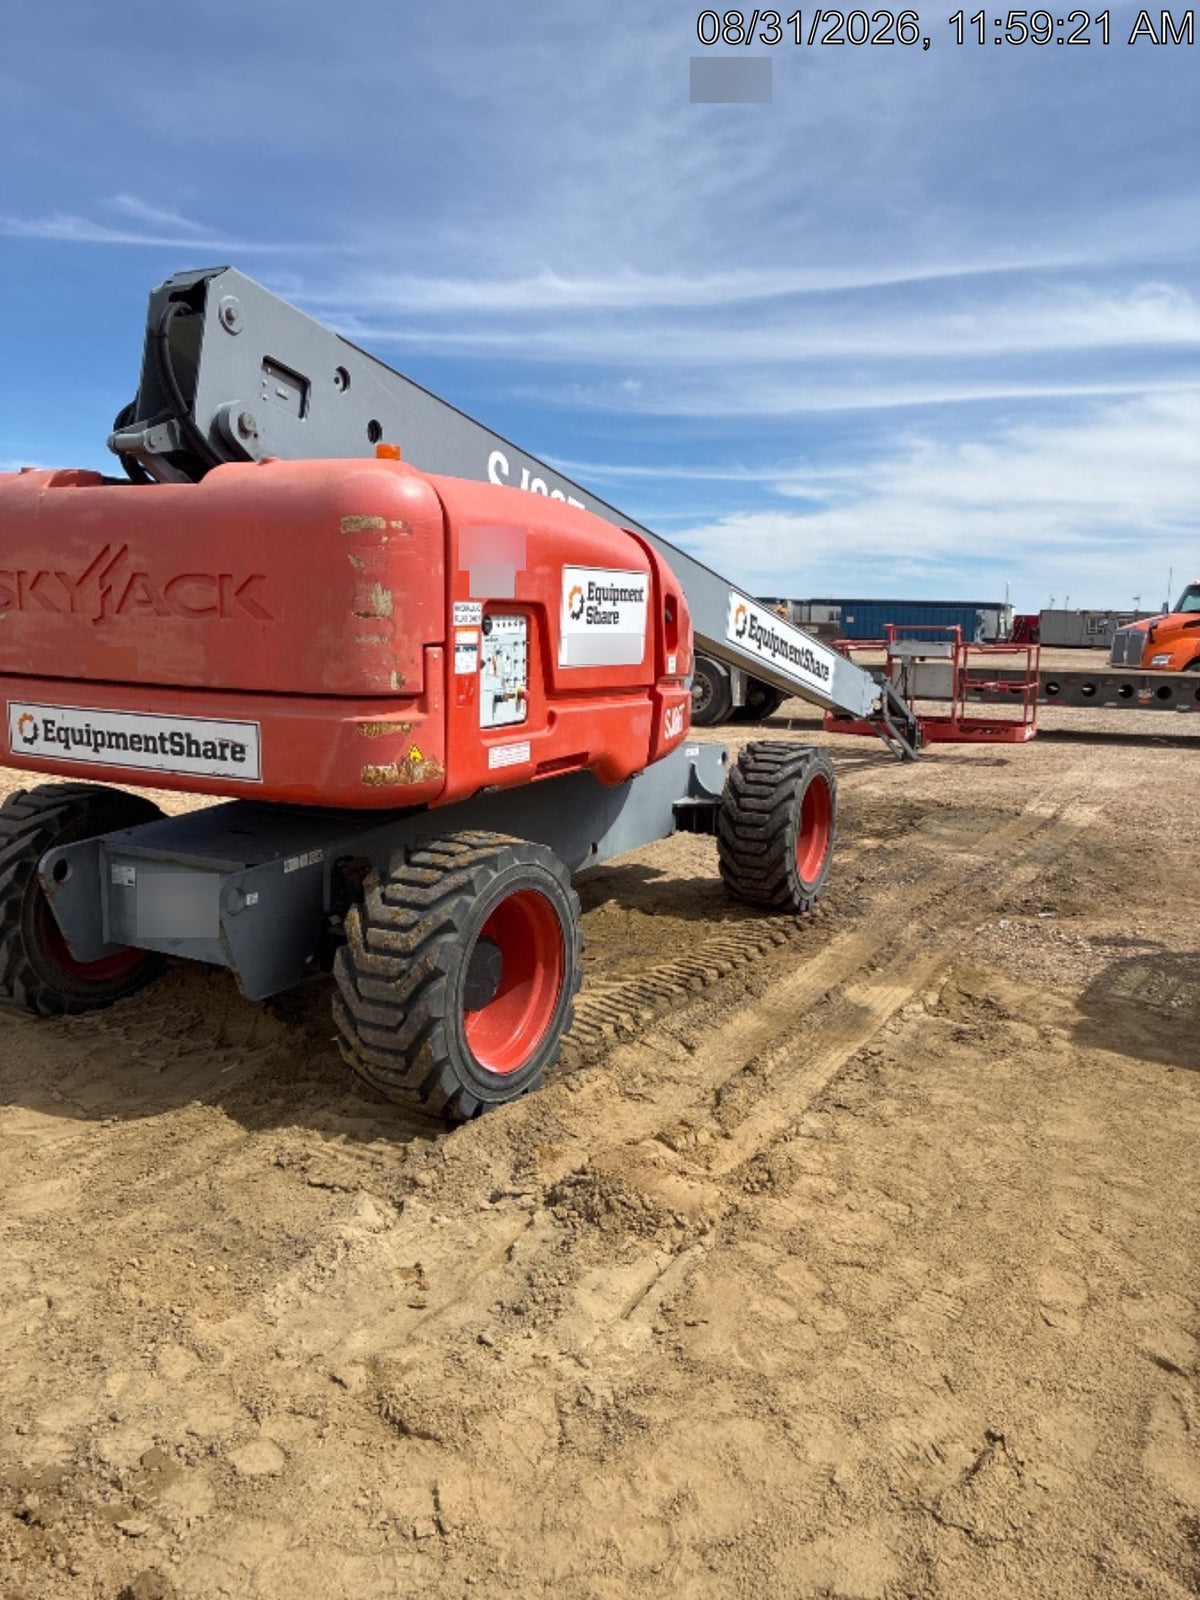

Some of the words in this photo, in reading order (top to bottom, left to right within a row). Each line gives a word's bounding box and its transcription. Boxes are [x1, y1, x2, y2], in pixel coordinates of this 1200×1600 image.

[587, 581, 645, 606] Equipment
[586, 605, 620, 625] Share
[748, 613, 830, 682] EquipmentShare
[42, 719, 246, 763] EquipmentShare
